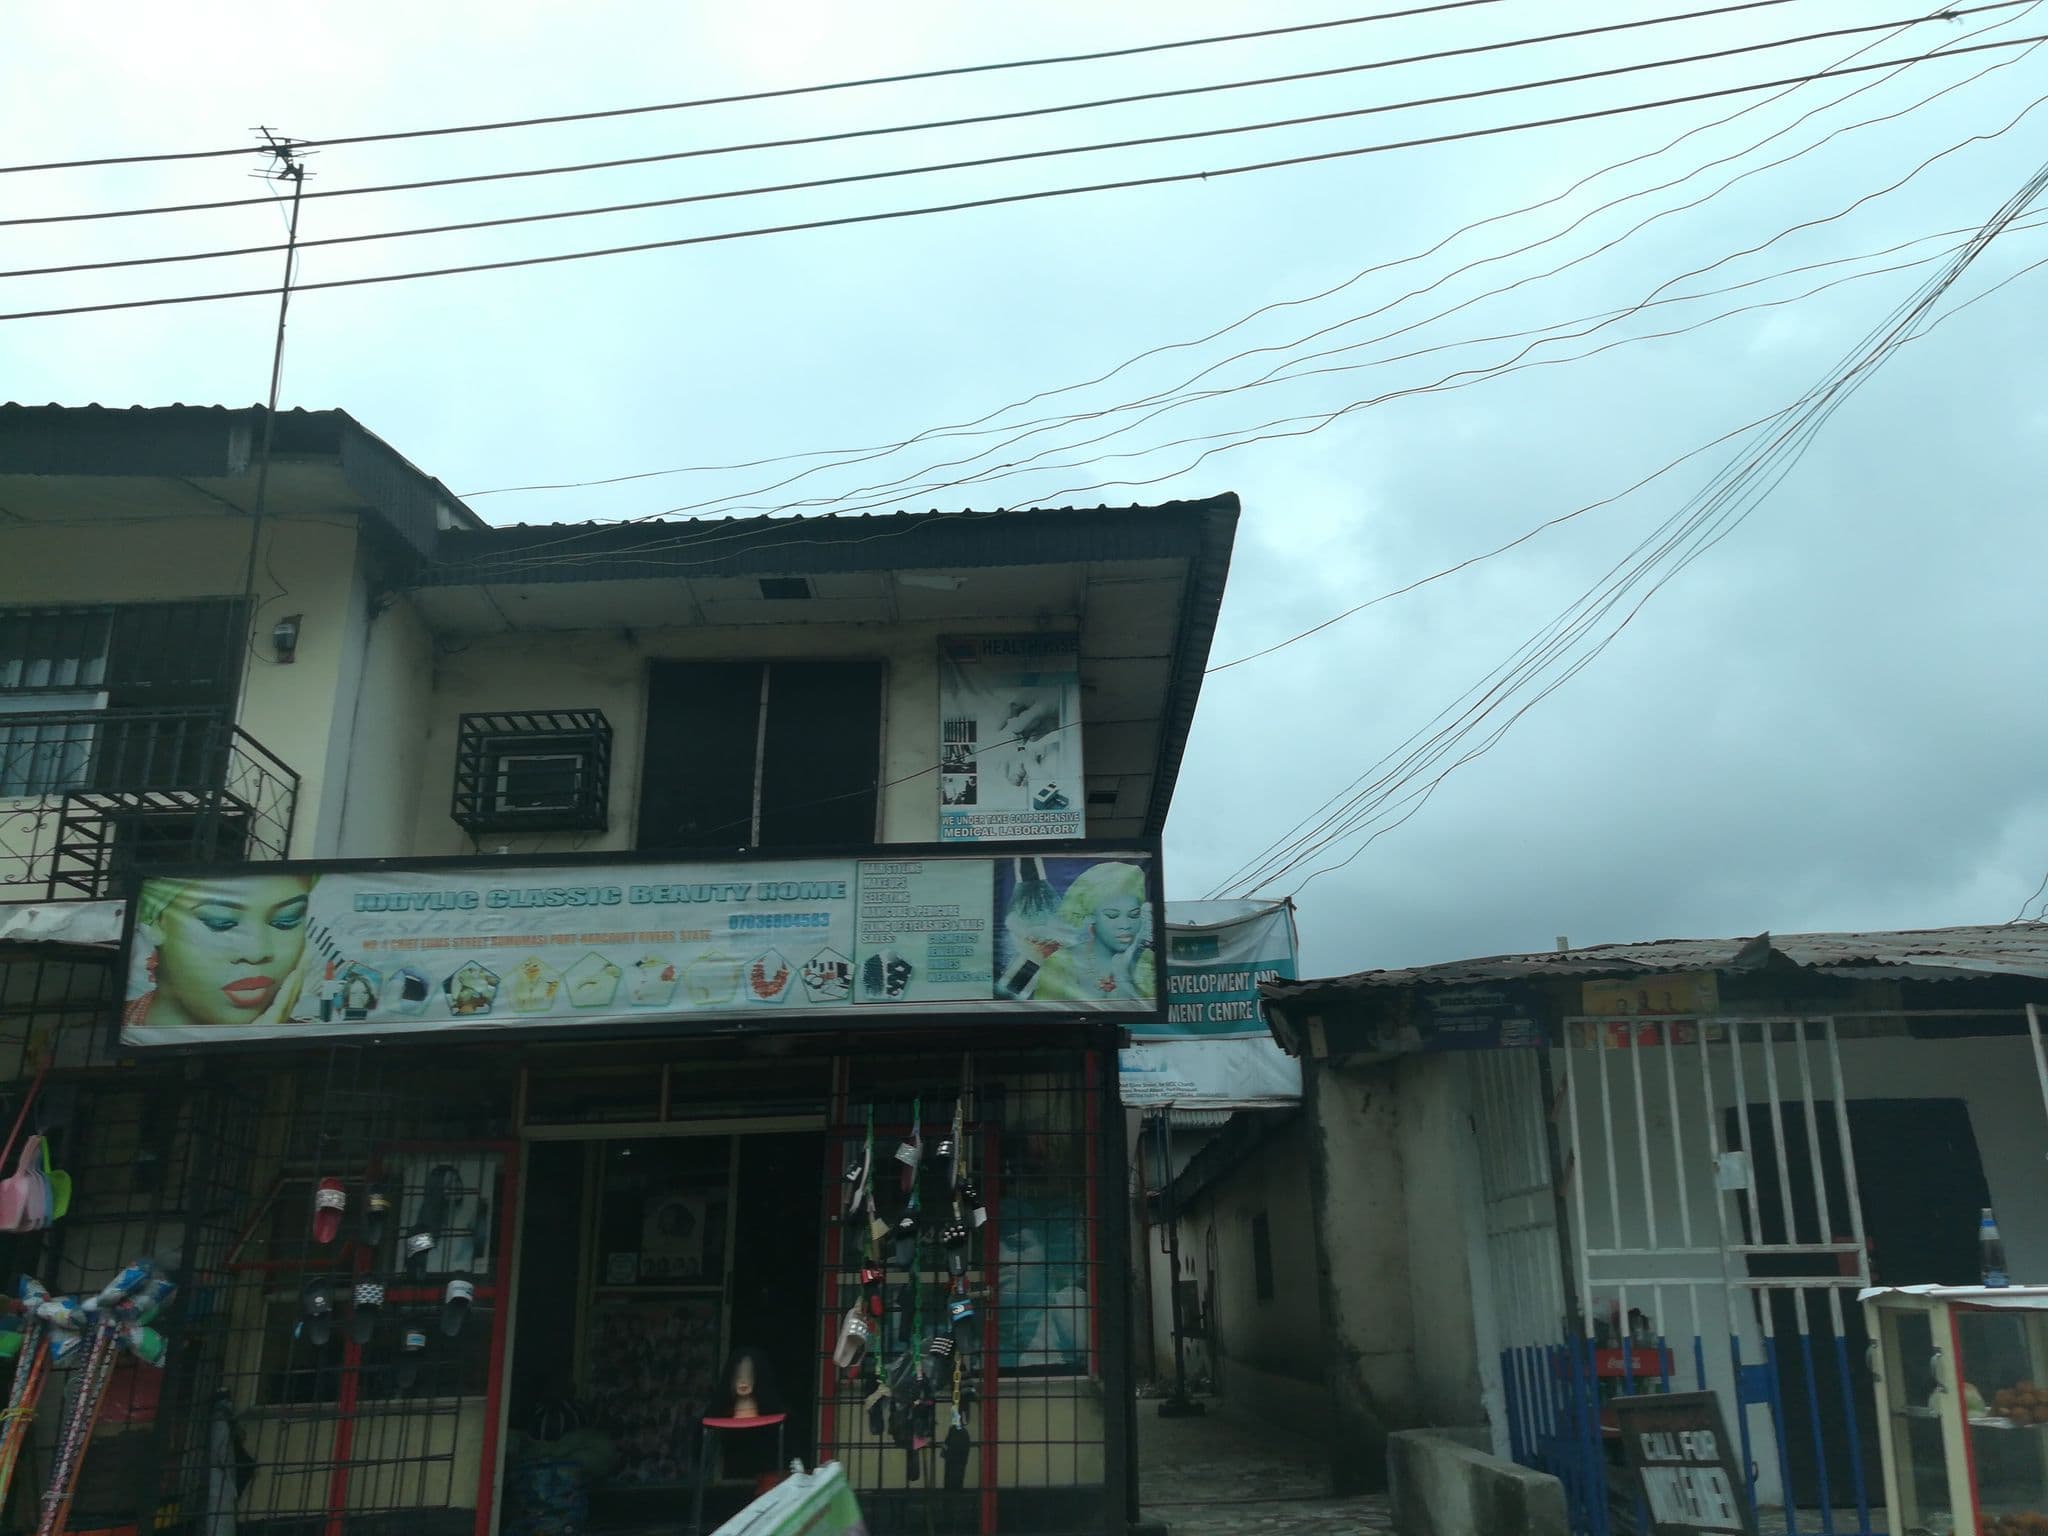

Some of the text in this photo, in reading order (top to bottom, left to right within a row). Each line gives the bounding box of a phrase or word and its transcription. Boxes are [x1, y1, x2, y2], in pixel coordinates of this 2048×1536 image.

[1009, 811, 1081, 824] COMPREHENSIVE
[943, 824, 1079, 838] MEDICAL LABORATORY
[355, 881, 847, 912] IDDYLIC CLASSIC BEAUTY HOME
[1207, 1001, 1254, 1022] CENTRE
